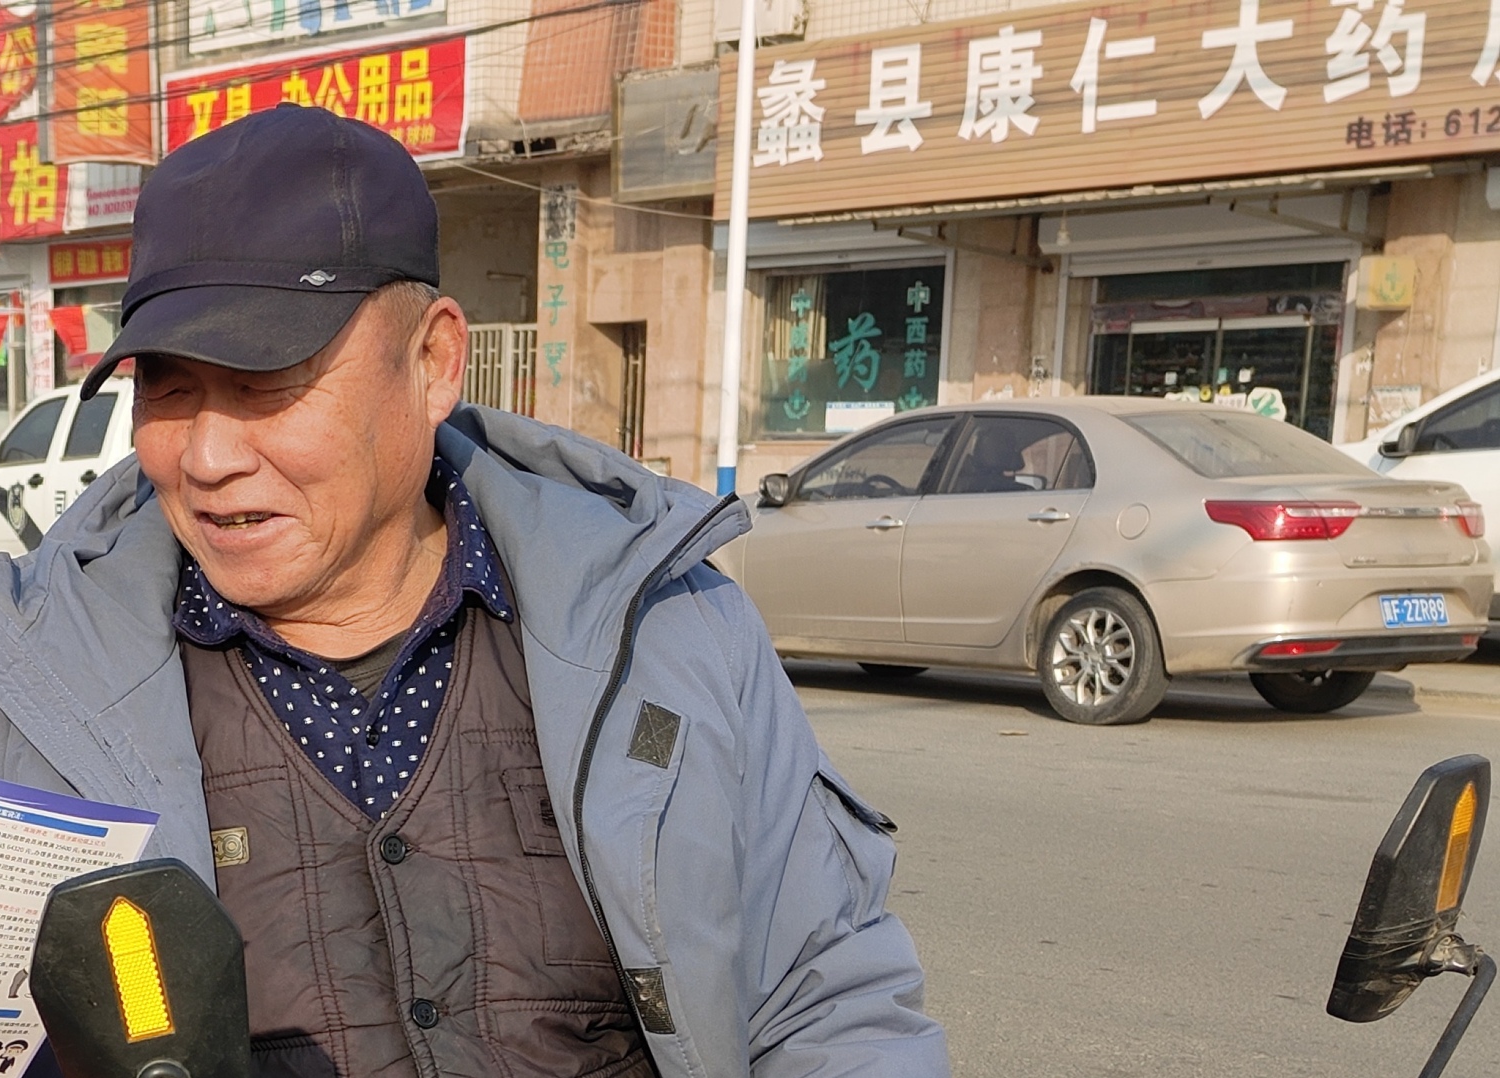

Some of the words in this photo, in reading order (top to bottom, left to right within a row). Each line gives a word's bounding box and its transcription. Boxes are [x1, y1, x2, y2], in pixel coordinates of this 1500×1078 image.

[74, 0, 129, 137] 宾馆
[753, 0, 1500, 167] 蠡县康仁大药
[828, 311, 882, 391] 药
[903, 280, 931, 379] 中西药
